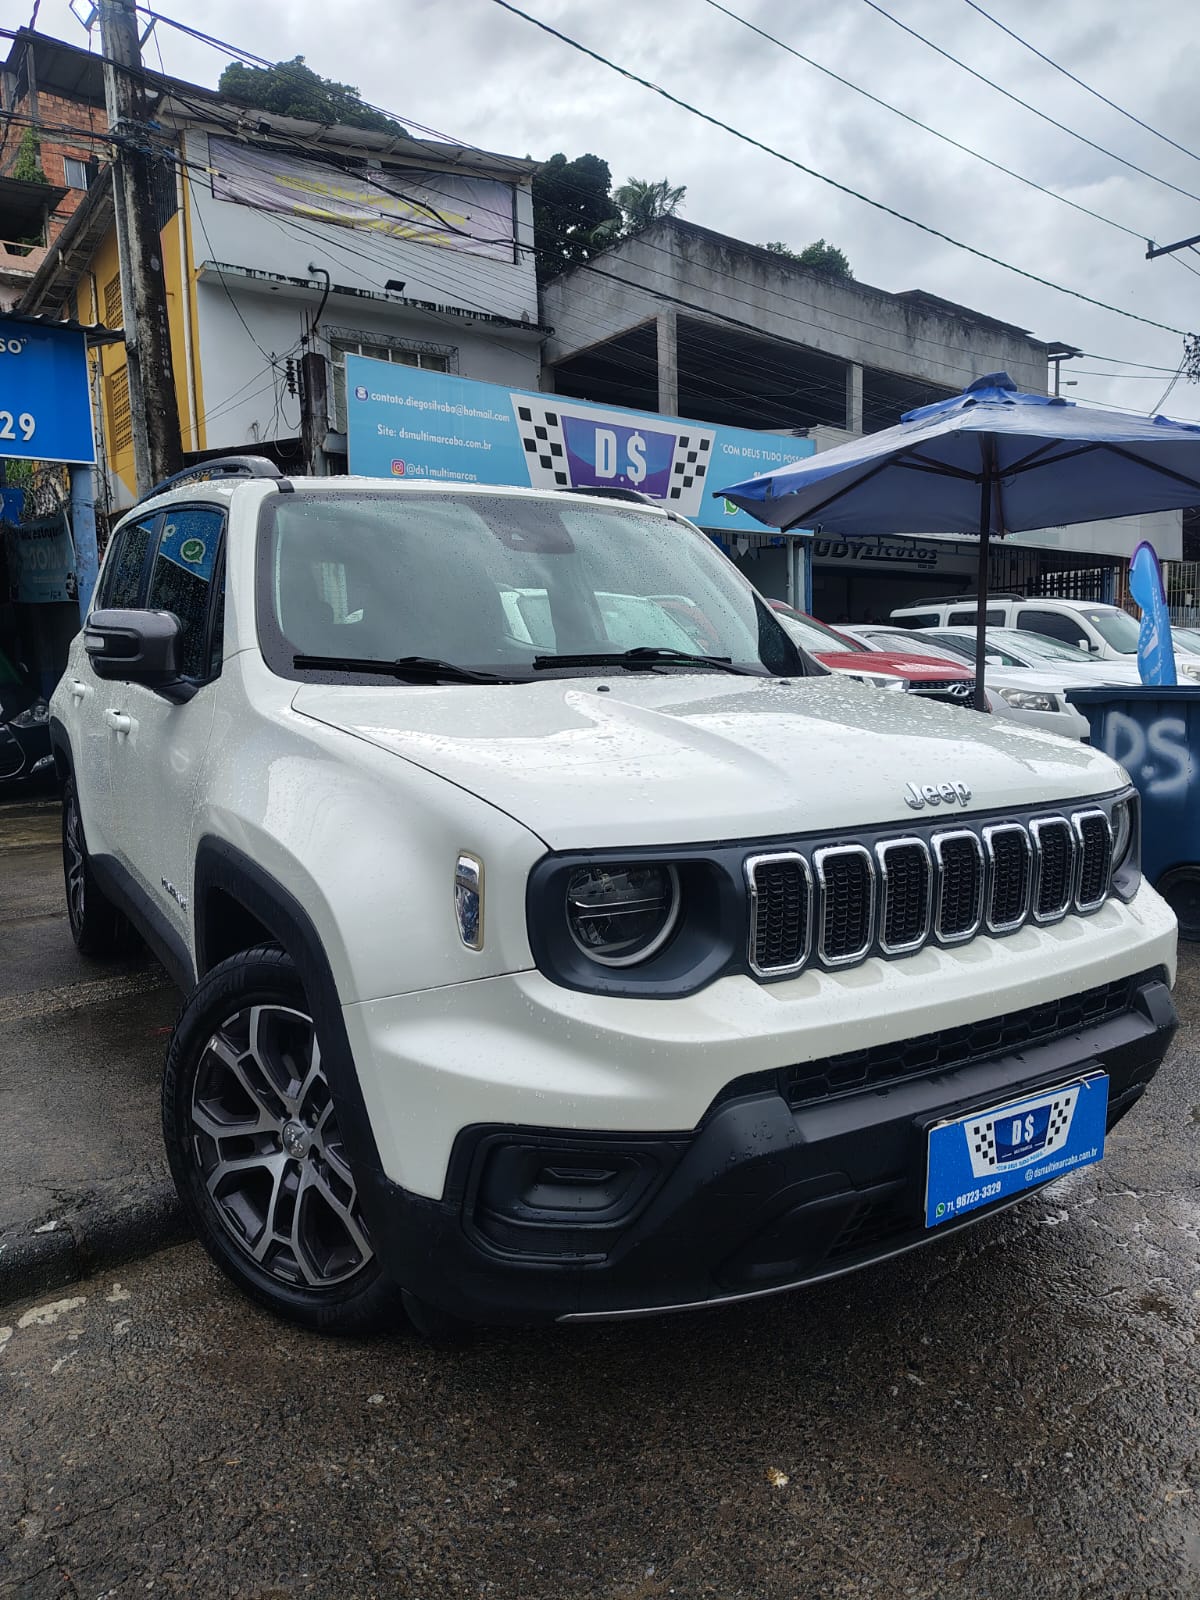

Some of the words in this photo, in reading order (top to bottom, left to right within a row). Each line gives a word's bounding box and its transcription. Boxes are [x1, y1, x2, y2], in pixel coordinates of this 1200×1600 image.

[0, 410, 36, 441] 29
[377, 423, 397, 437] Site:
[399, 427, 492, 451] dsmultimarcaba.com.br
[741, 447, 761, 459] DEUS
[762, 450, 782, 462] TUDO
[406, 463, 478, 482] @ds1multimarcas
[903, 780, 972, 811] Jeep
[956, 1180, 1002, 1209] 98723-3329
